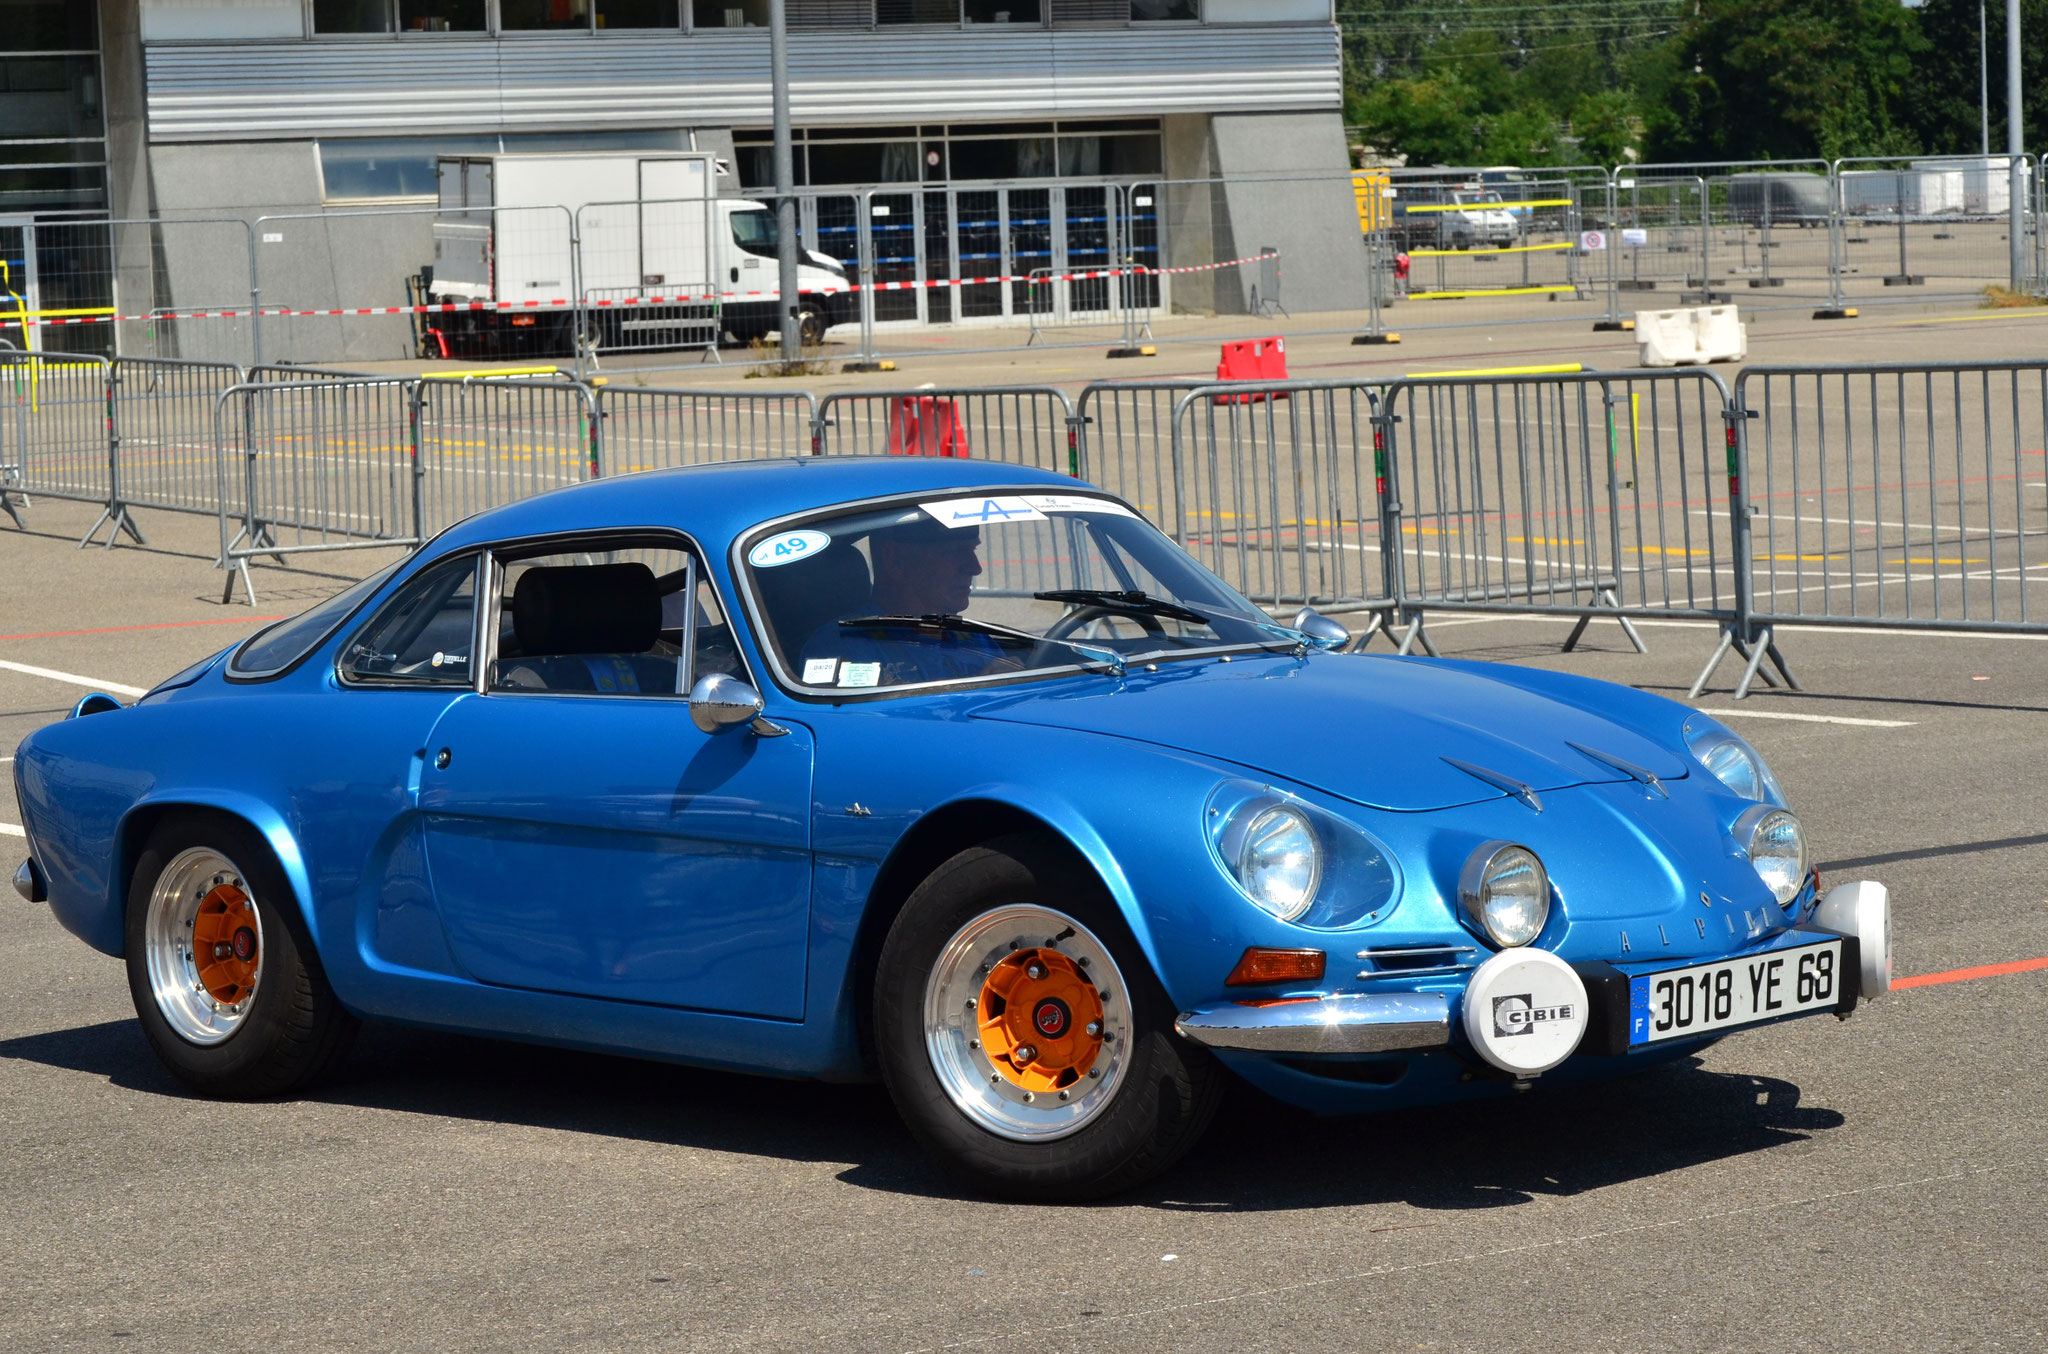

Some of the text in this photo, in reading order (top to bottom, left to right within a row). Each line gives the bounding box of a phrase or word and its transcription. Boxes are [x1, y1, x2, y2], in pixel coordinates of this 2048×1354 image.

[775, 537, 807, 556] 49
[1656, 950, 1833, 1031] 3018 YE 68
[1634, 1018, 1643, 1033] F
